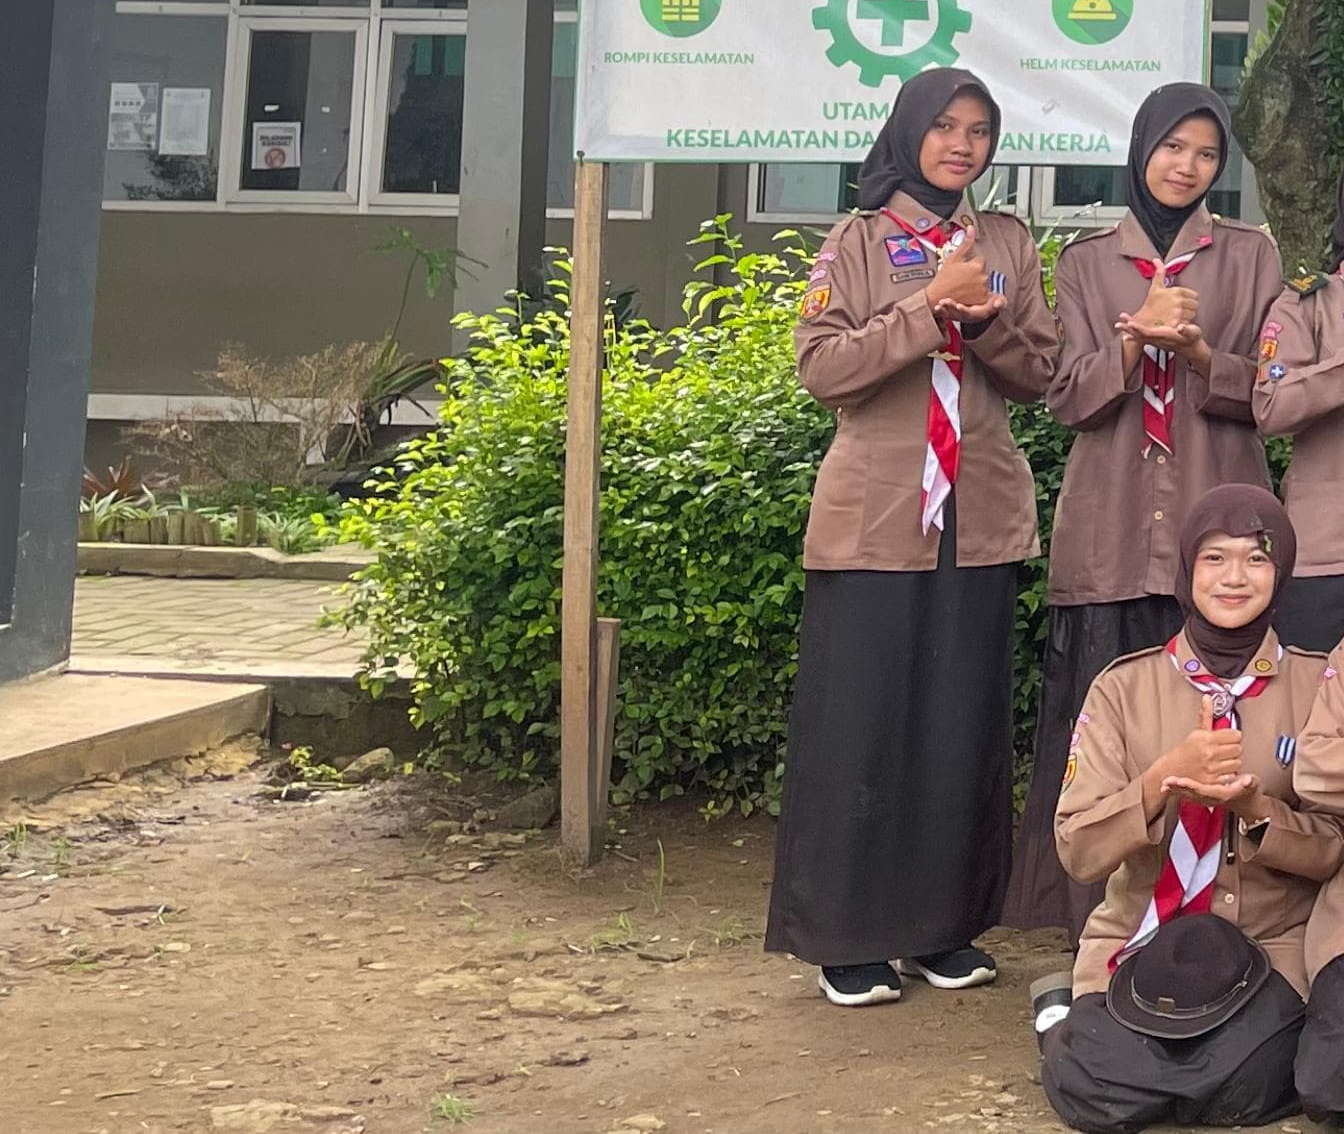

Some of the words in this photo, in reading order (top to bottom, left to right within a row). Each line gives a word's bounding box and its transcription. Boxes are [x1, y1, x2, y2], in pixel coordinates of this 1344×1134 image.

[604, 52, 650, 63] ROMPI
[653, 52, 754, 64] KESELAMATAN
[1020, 58, 1057, 70] HELM
[1062, 59, 1161, 71] KESELAMATAN
[823, 102, 890, 120] UTAM
[666, 129, 838, 148] KESELAMATAN
[844, 130, 875, 149] DA
[1040, 133, 1111, 153] KERJA
